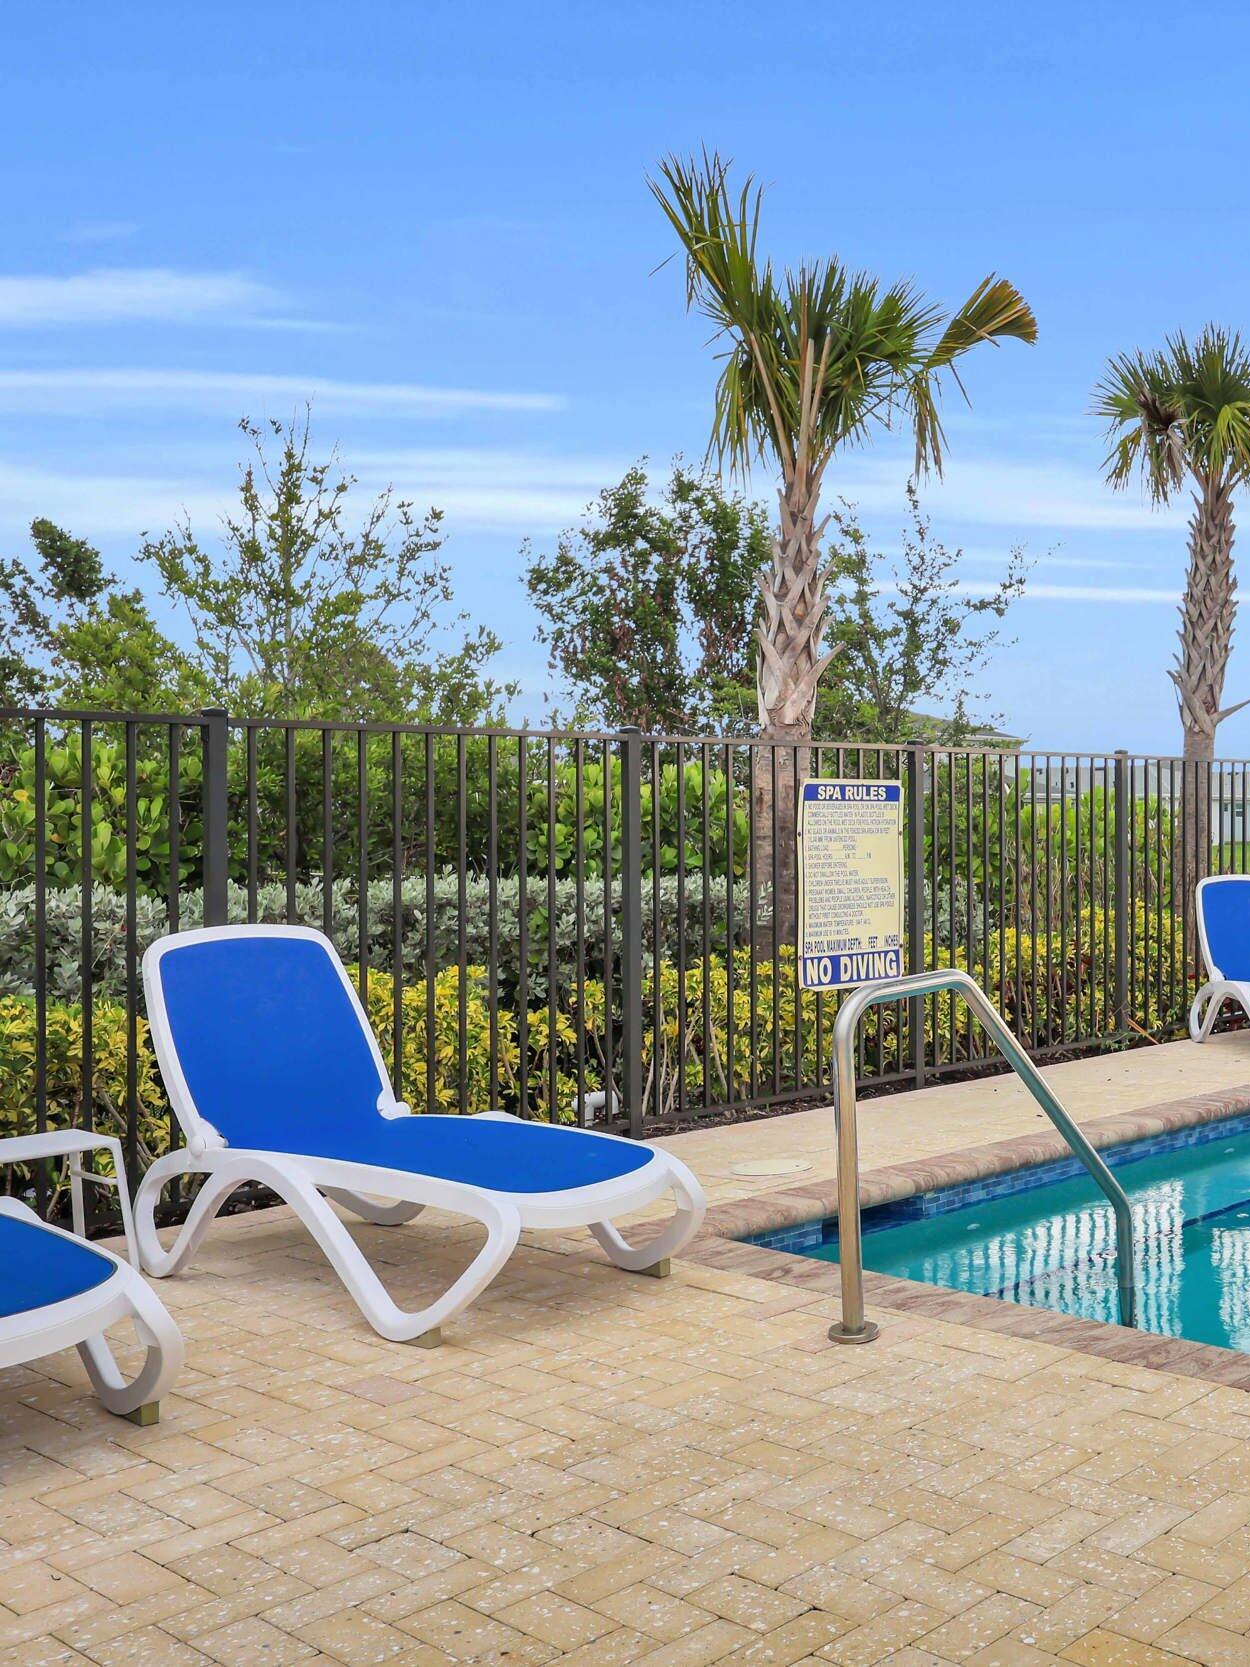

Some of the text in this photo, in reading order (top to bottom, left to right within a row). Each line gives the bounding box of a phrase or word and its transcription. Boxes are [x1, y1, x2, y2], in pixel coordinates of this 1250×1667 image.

[818, 786, 886, 801] SPA RULES
[804, 940, 813, 954] SPA
[814, 940, 826, 953] POOL
[868, 935, 878, 949] FEET
[806, 951, 898, 985] NO DIVING
